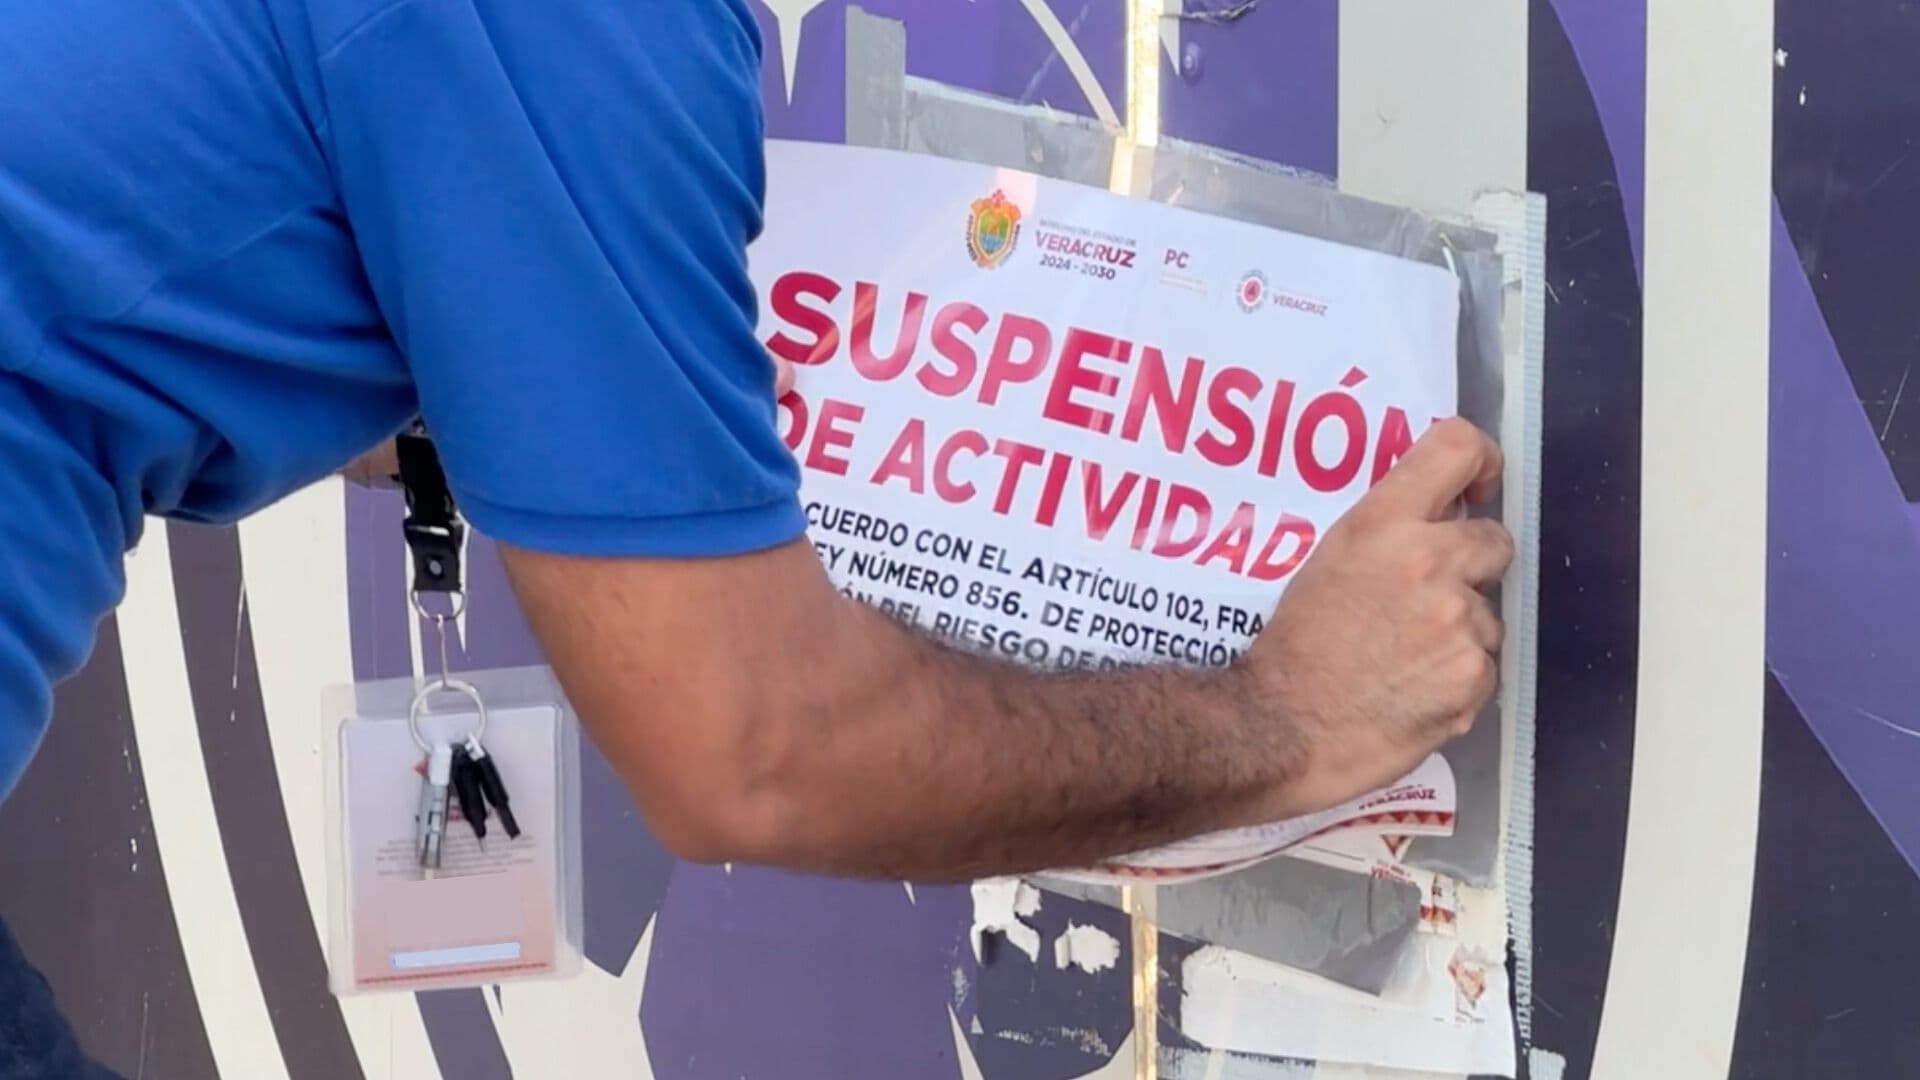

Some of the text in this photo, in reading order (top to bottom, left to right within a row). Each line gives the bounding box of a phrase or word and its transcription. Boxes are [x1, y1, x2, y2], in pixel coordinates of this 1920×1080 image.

[1035, 230, 1137, 269] VERACRUZ
[1164, 249, 1190, 269] PC
[1039, 253, 1072, 271] 2024
[1081, 262, 1116, 281] 2030
[1272, 293, 1328, 317] VERACRUZ
[848, 550, 959, 599] NÚMERO
[966, 581, 1028, 620] 856.
[1040, 600, 1083, 634] DE
[915, 529, 973, 564] CON
[977, 544, 1012, 575] EL
[1021, 557, 1159, 612] ARTÍCULO
[1166, 591, 1209, 631] 102,
[1216, 604, 1264, 638] FRA
